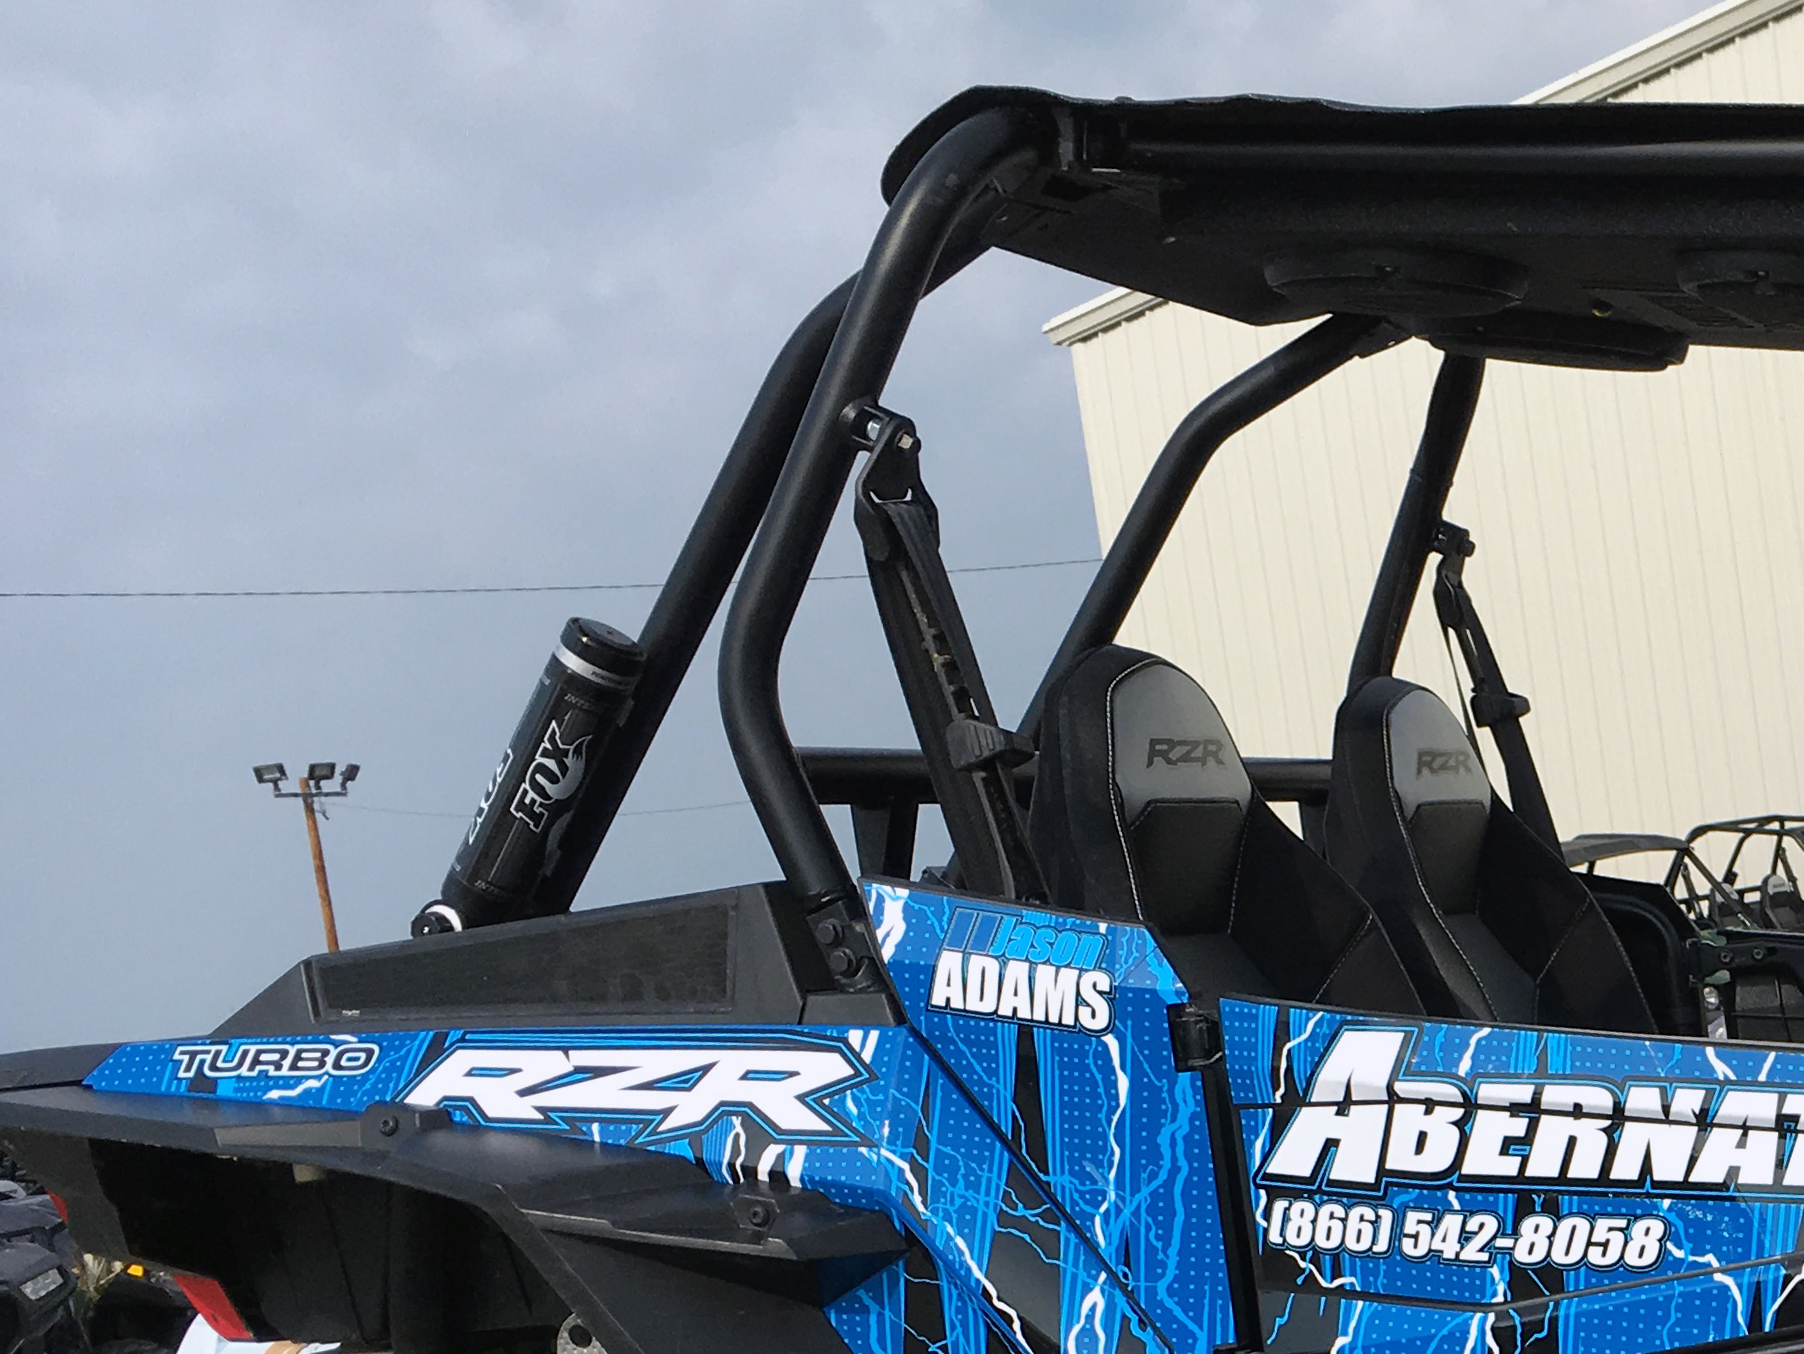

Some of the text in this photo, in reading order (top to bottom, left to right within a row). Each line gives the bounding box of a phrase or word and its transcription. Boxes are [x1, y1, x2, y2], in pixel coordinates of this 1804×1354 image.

[510, 719, 593, 833] FOX
[1146, 738, 1226, 769] RZR
[1417, 750, 1473, 779] RZR
[989, 916, 1104, 969] Jason
[931, 950, 1112, 1031] ADAMS
[174, 1043, 381, 1077] TURBO
[404, 1049, 836, 1133] RZR
[1267, 1199, 1665, 1268] (866) 542-8058
